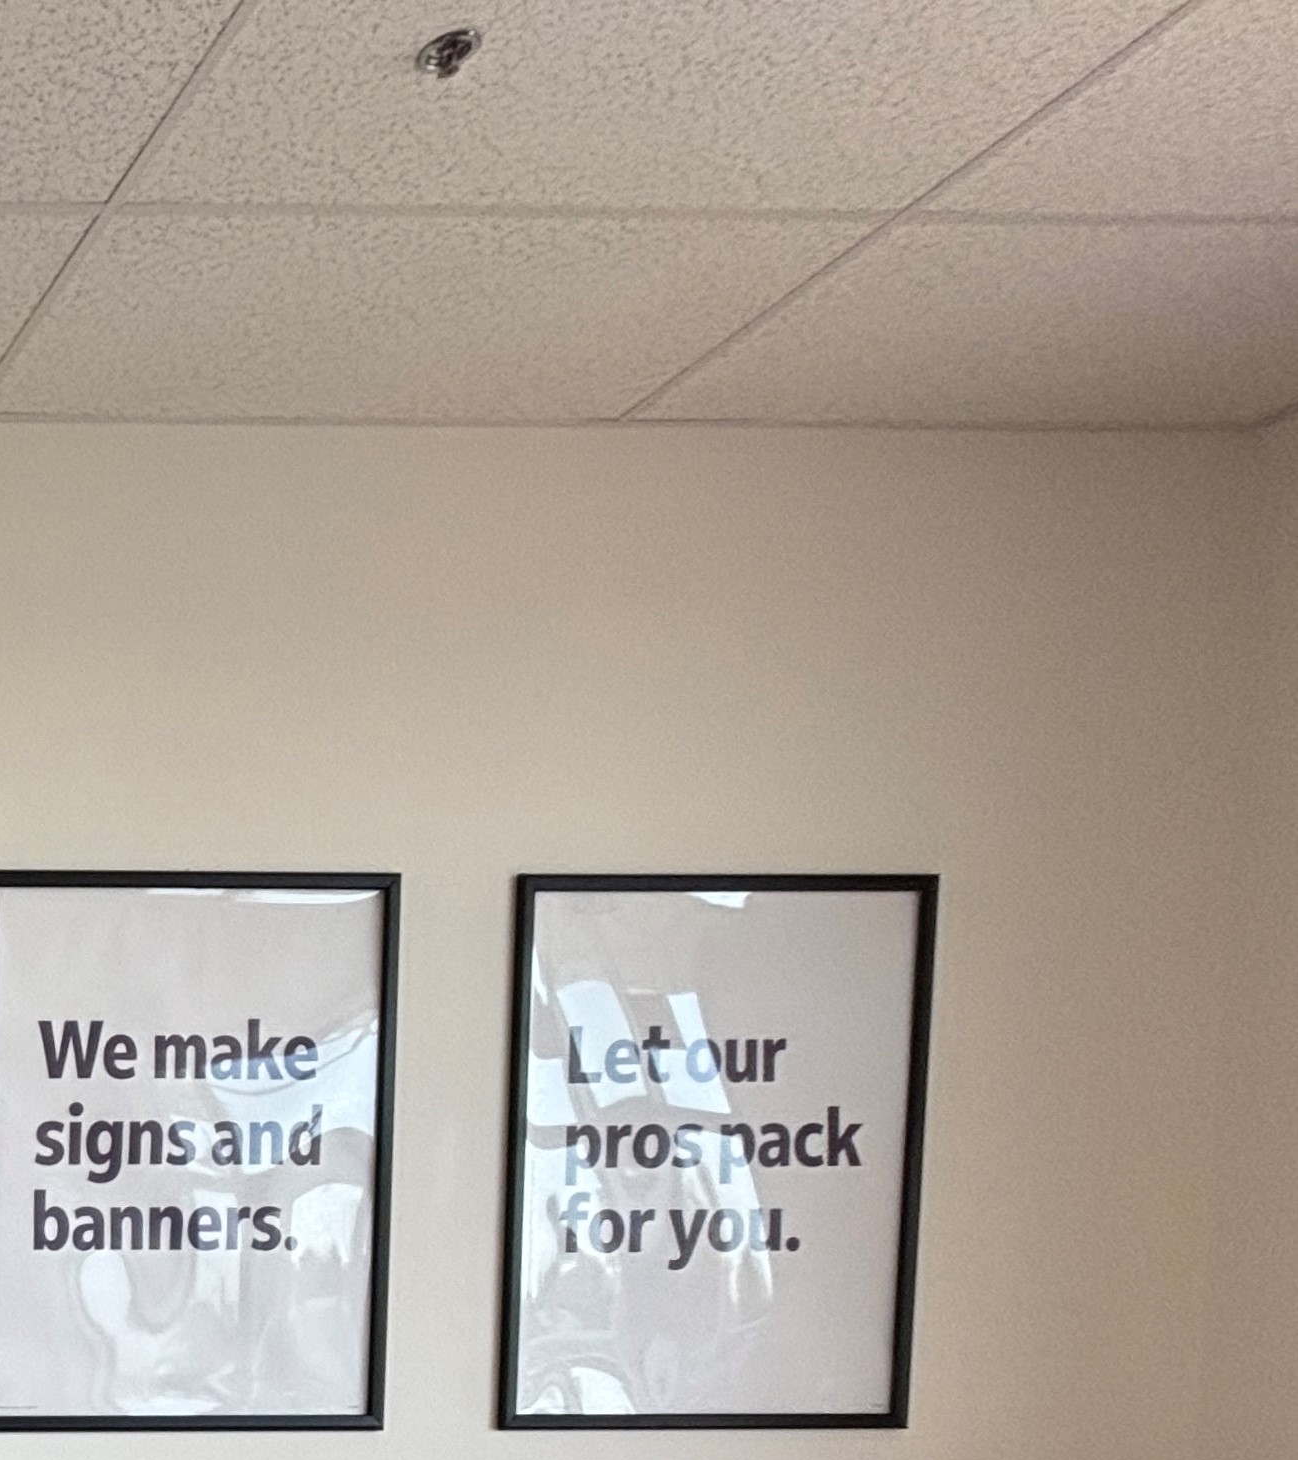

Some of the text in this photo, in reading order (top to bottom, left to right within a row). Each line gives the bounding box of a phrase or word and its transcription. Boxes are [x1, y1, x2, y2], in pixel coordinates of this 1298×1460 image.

[38, 1018, 319, 1081] We make
[567, 1025, 787, 1084] Let our
[34, 1101, 324, 1184] signs and
[565, 1105, 864, 1187] pros pack
[32, 1191, 299, 1252] banners.
[559, 1191, 801, 1271] for you.
